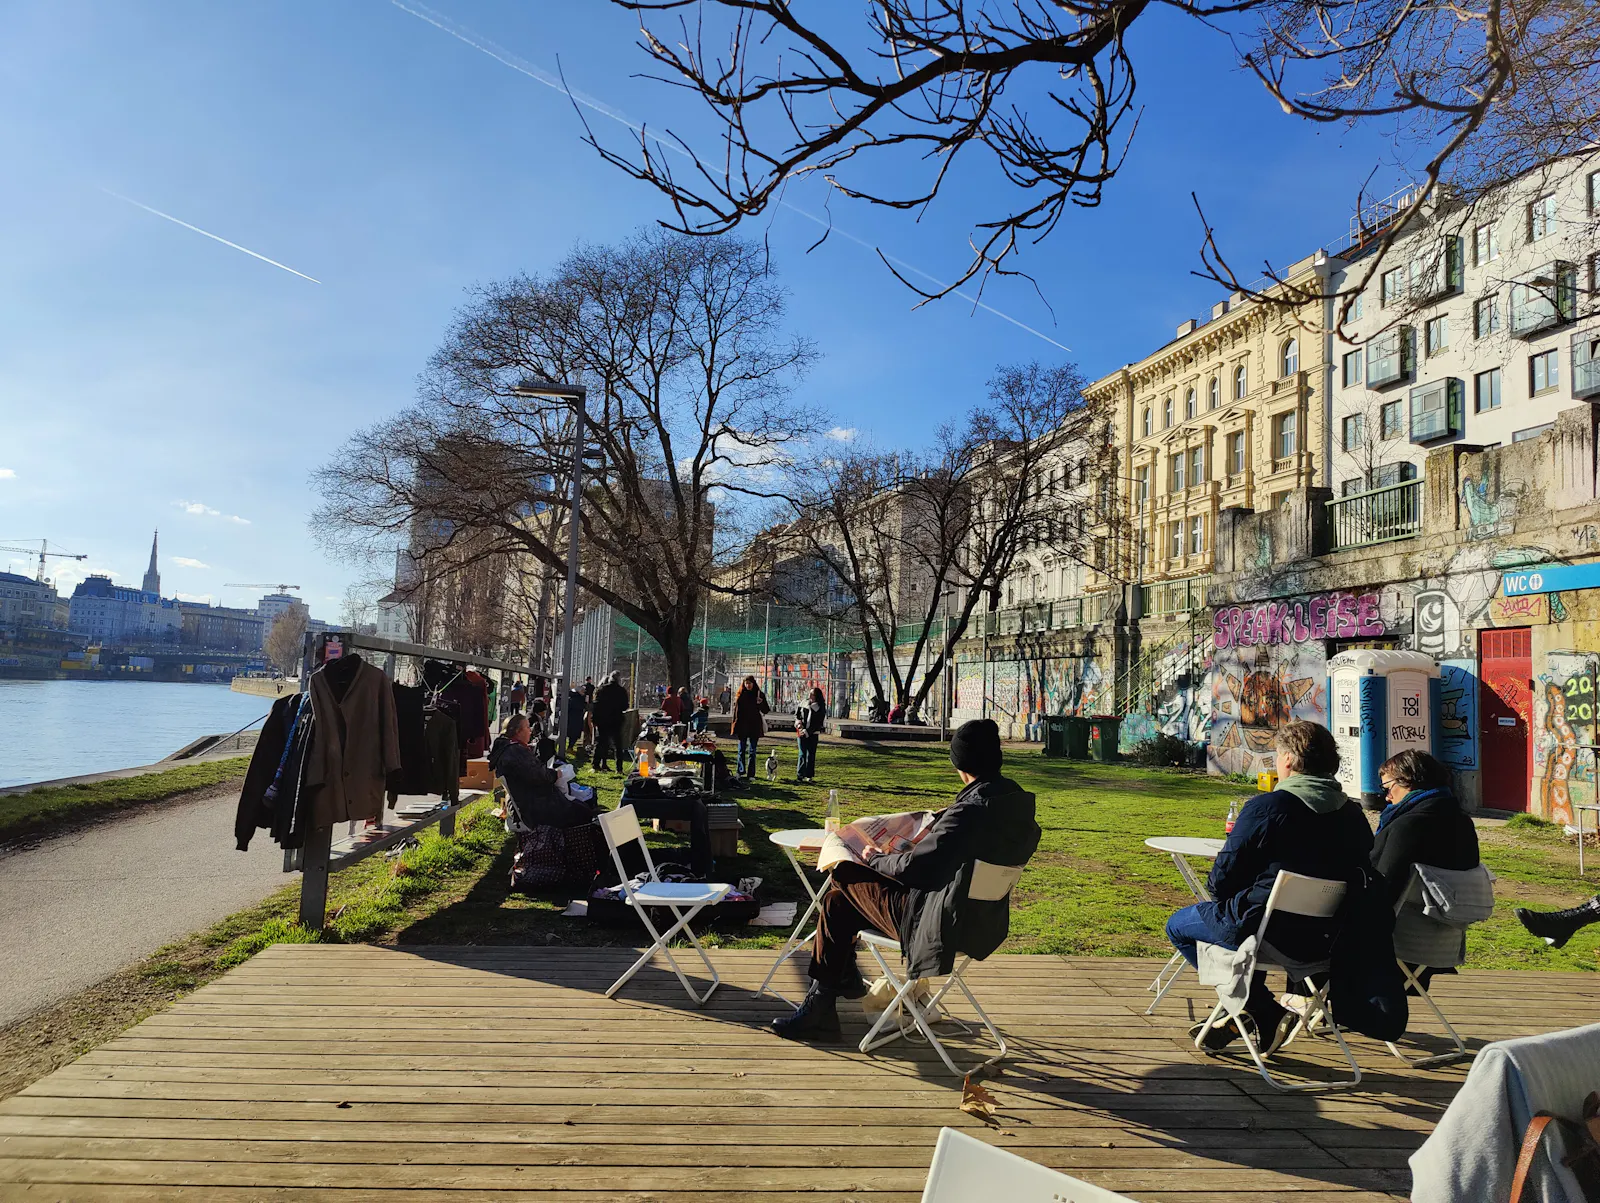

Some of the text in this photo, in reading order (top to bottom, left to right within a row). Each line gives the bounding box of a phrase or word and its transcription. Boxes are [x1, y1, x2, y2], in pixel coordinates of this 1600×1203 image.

[1505, 575, 1527, 593] WC
[1213, 602, 1291, 649] SPEAK
[1402, 706, 1419, 717] TOI
